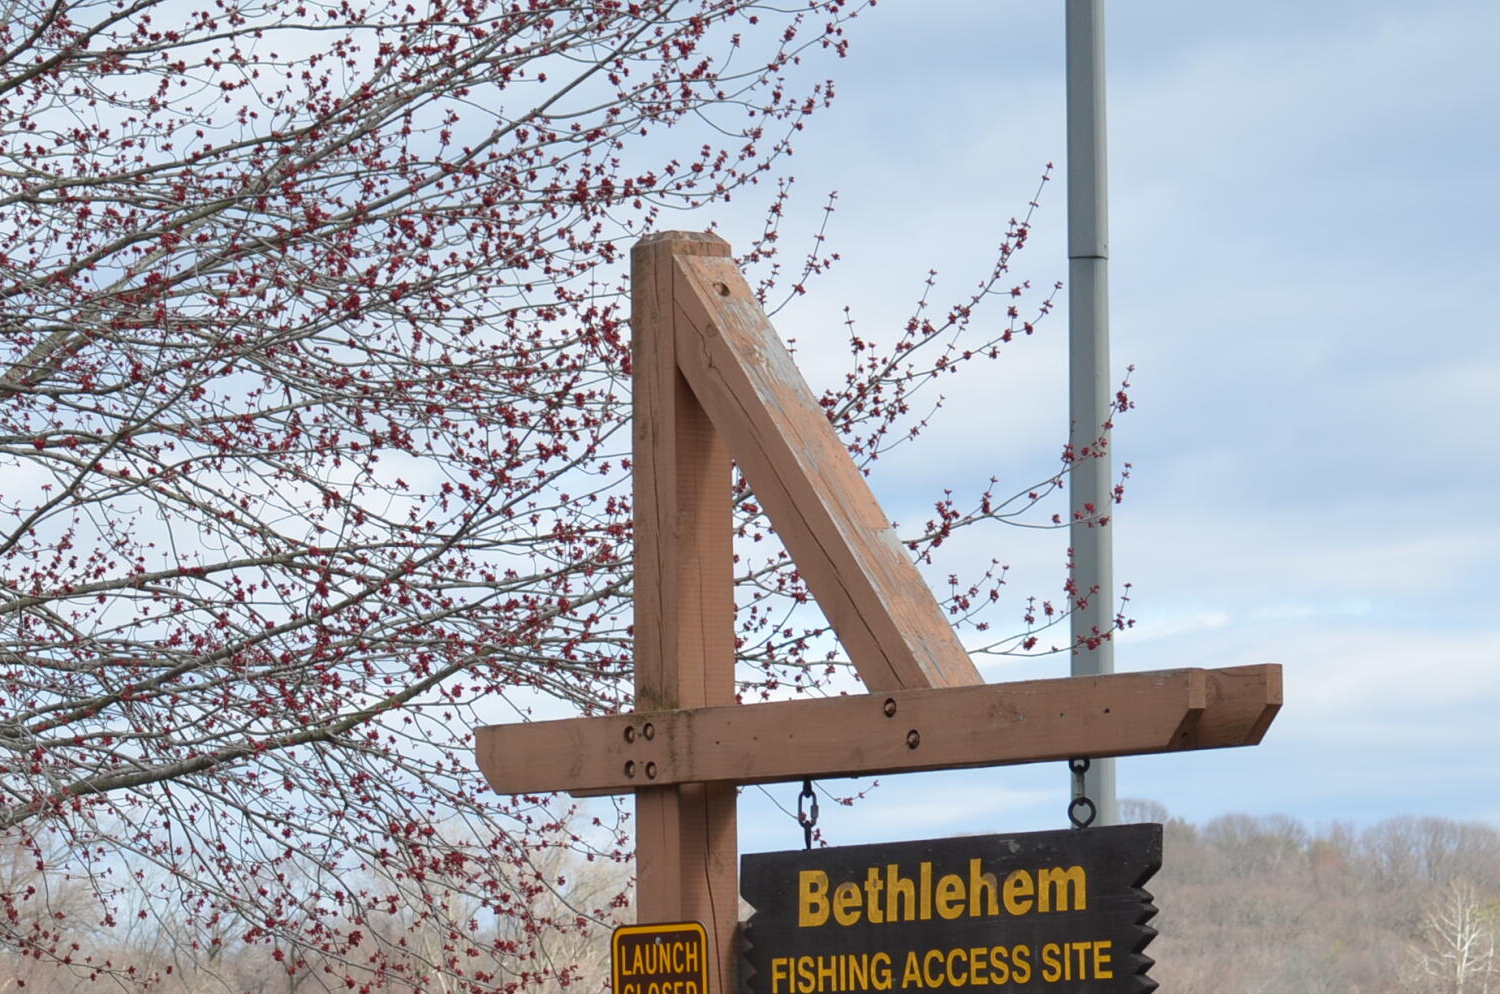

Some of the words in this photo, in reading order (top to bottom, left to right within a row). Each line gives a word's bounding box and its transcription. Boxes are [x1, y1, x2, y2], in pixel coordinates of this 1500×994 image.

[799, 858, 1087, 928] Bethlehem
[621, 941, 698, 976] LAUNCH
[771, 952, 892, 994] FISHING
[902, 945, 1031, 989] ACCESS
[1042, 940, 1114, 983] SITE
